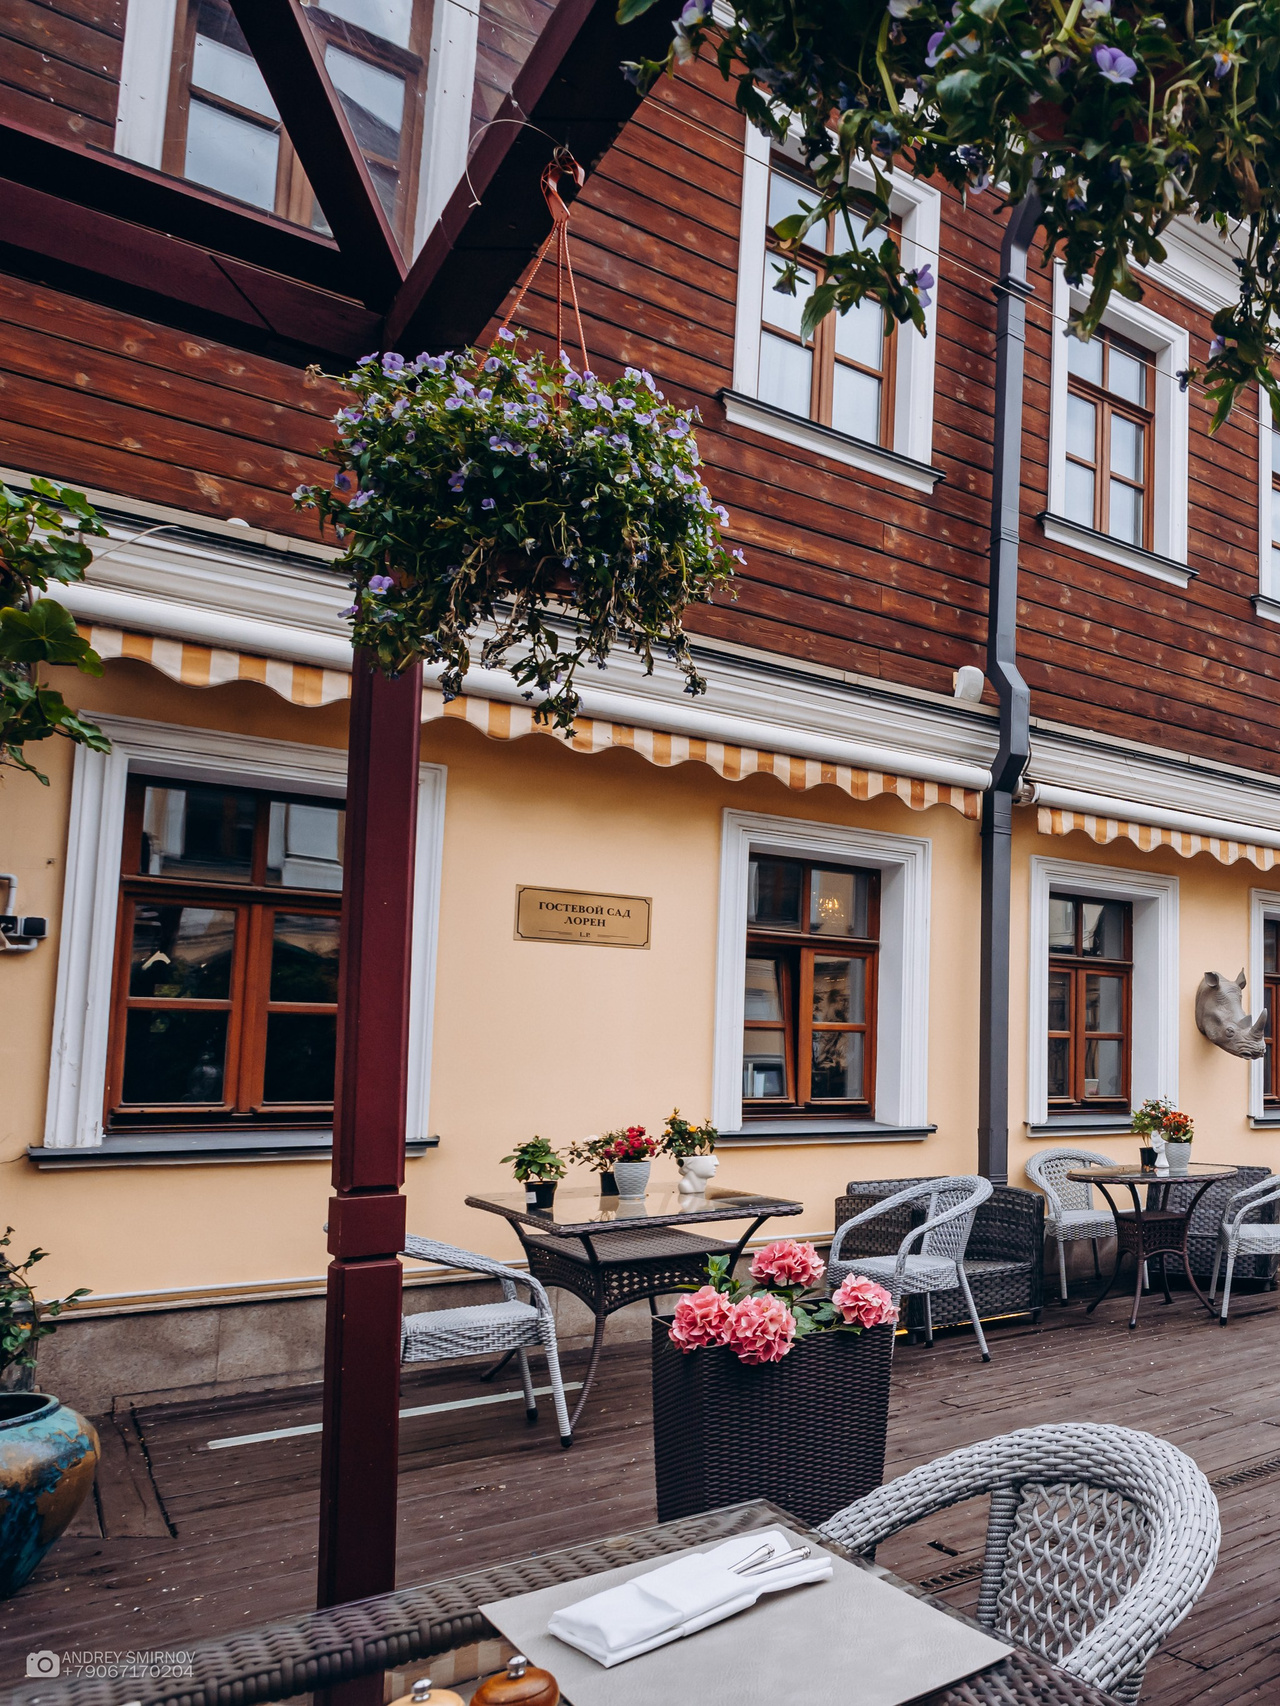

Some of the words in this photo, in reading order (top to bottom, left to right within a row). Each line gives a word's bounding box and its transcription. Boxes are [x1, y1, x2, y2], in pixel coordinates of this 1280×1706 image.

[539, 901, 603, 914] ГОСТЕВОЙ
[606, 908, 631, 919] САД
[564, 916, 606, 927] ЛОРЕН
